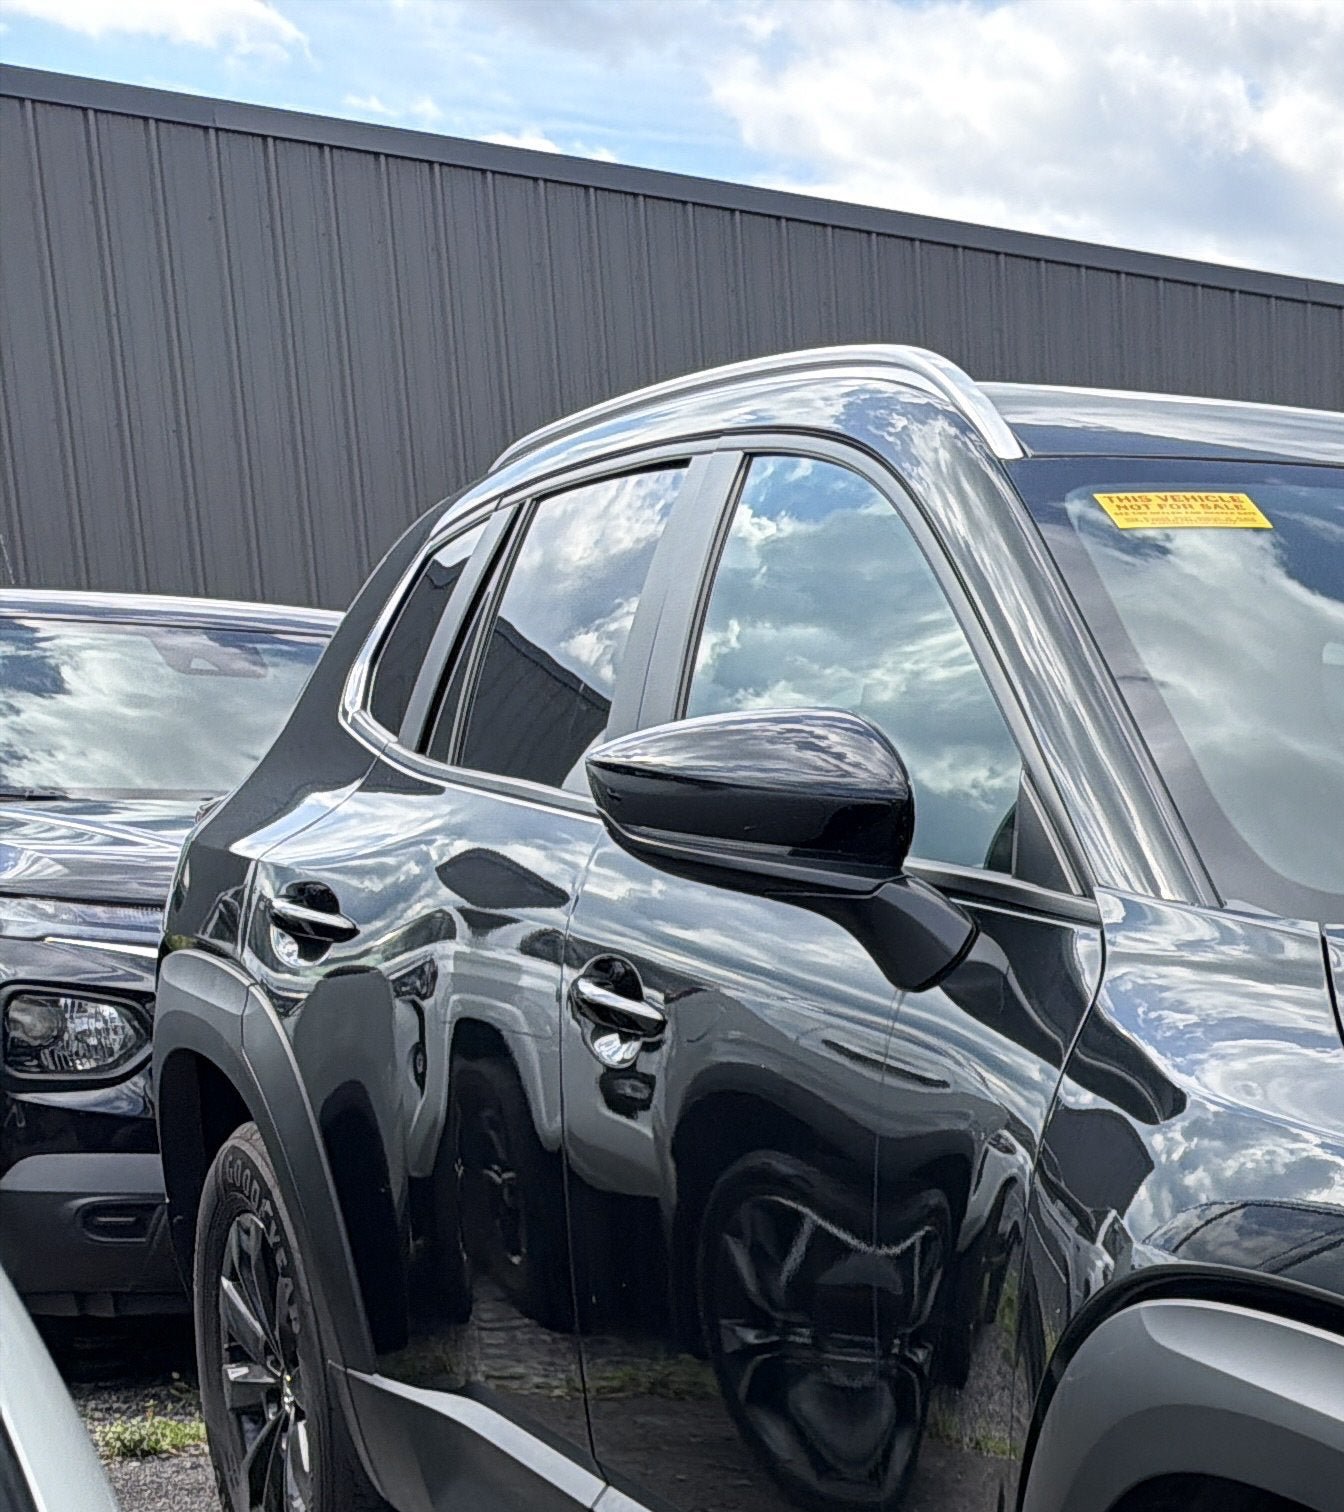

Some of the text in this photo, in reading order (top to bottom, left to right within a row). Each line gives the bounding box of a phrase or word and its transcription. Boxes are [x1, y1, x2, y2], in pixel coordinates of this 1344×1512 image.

[1103, 494, 1246, 505] THIS VEHICLE
[1115, 503, 1247, 511] NOT FOR SALE
